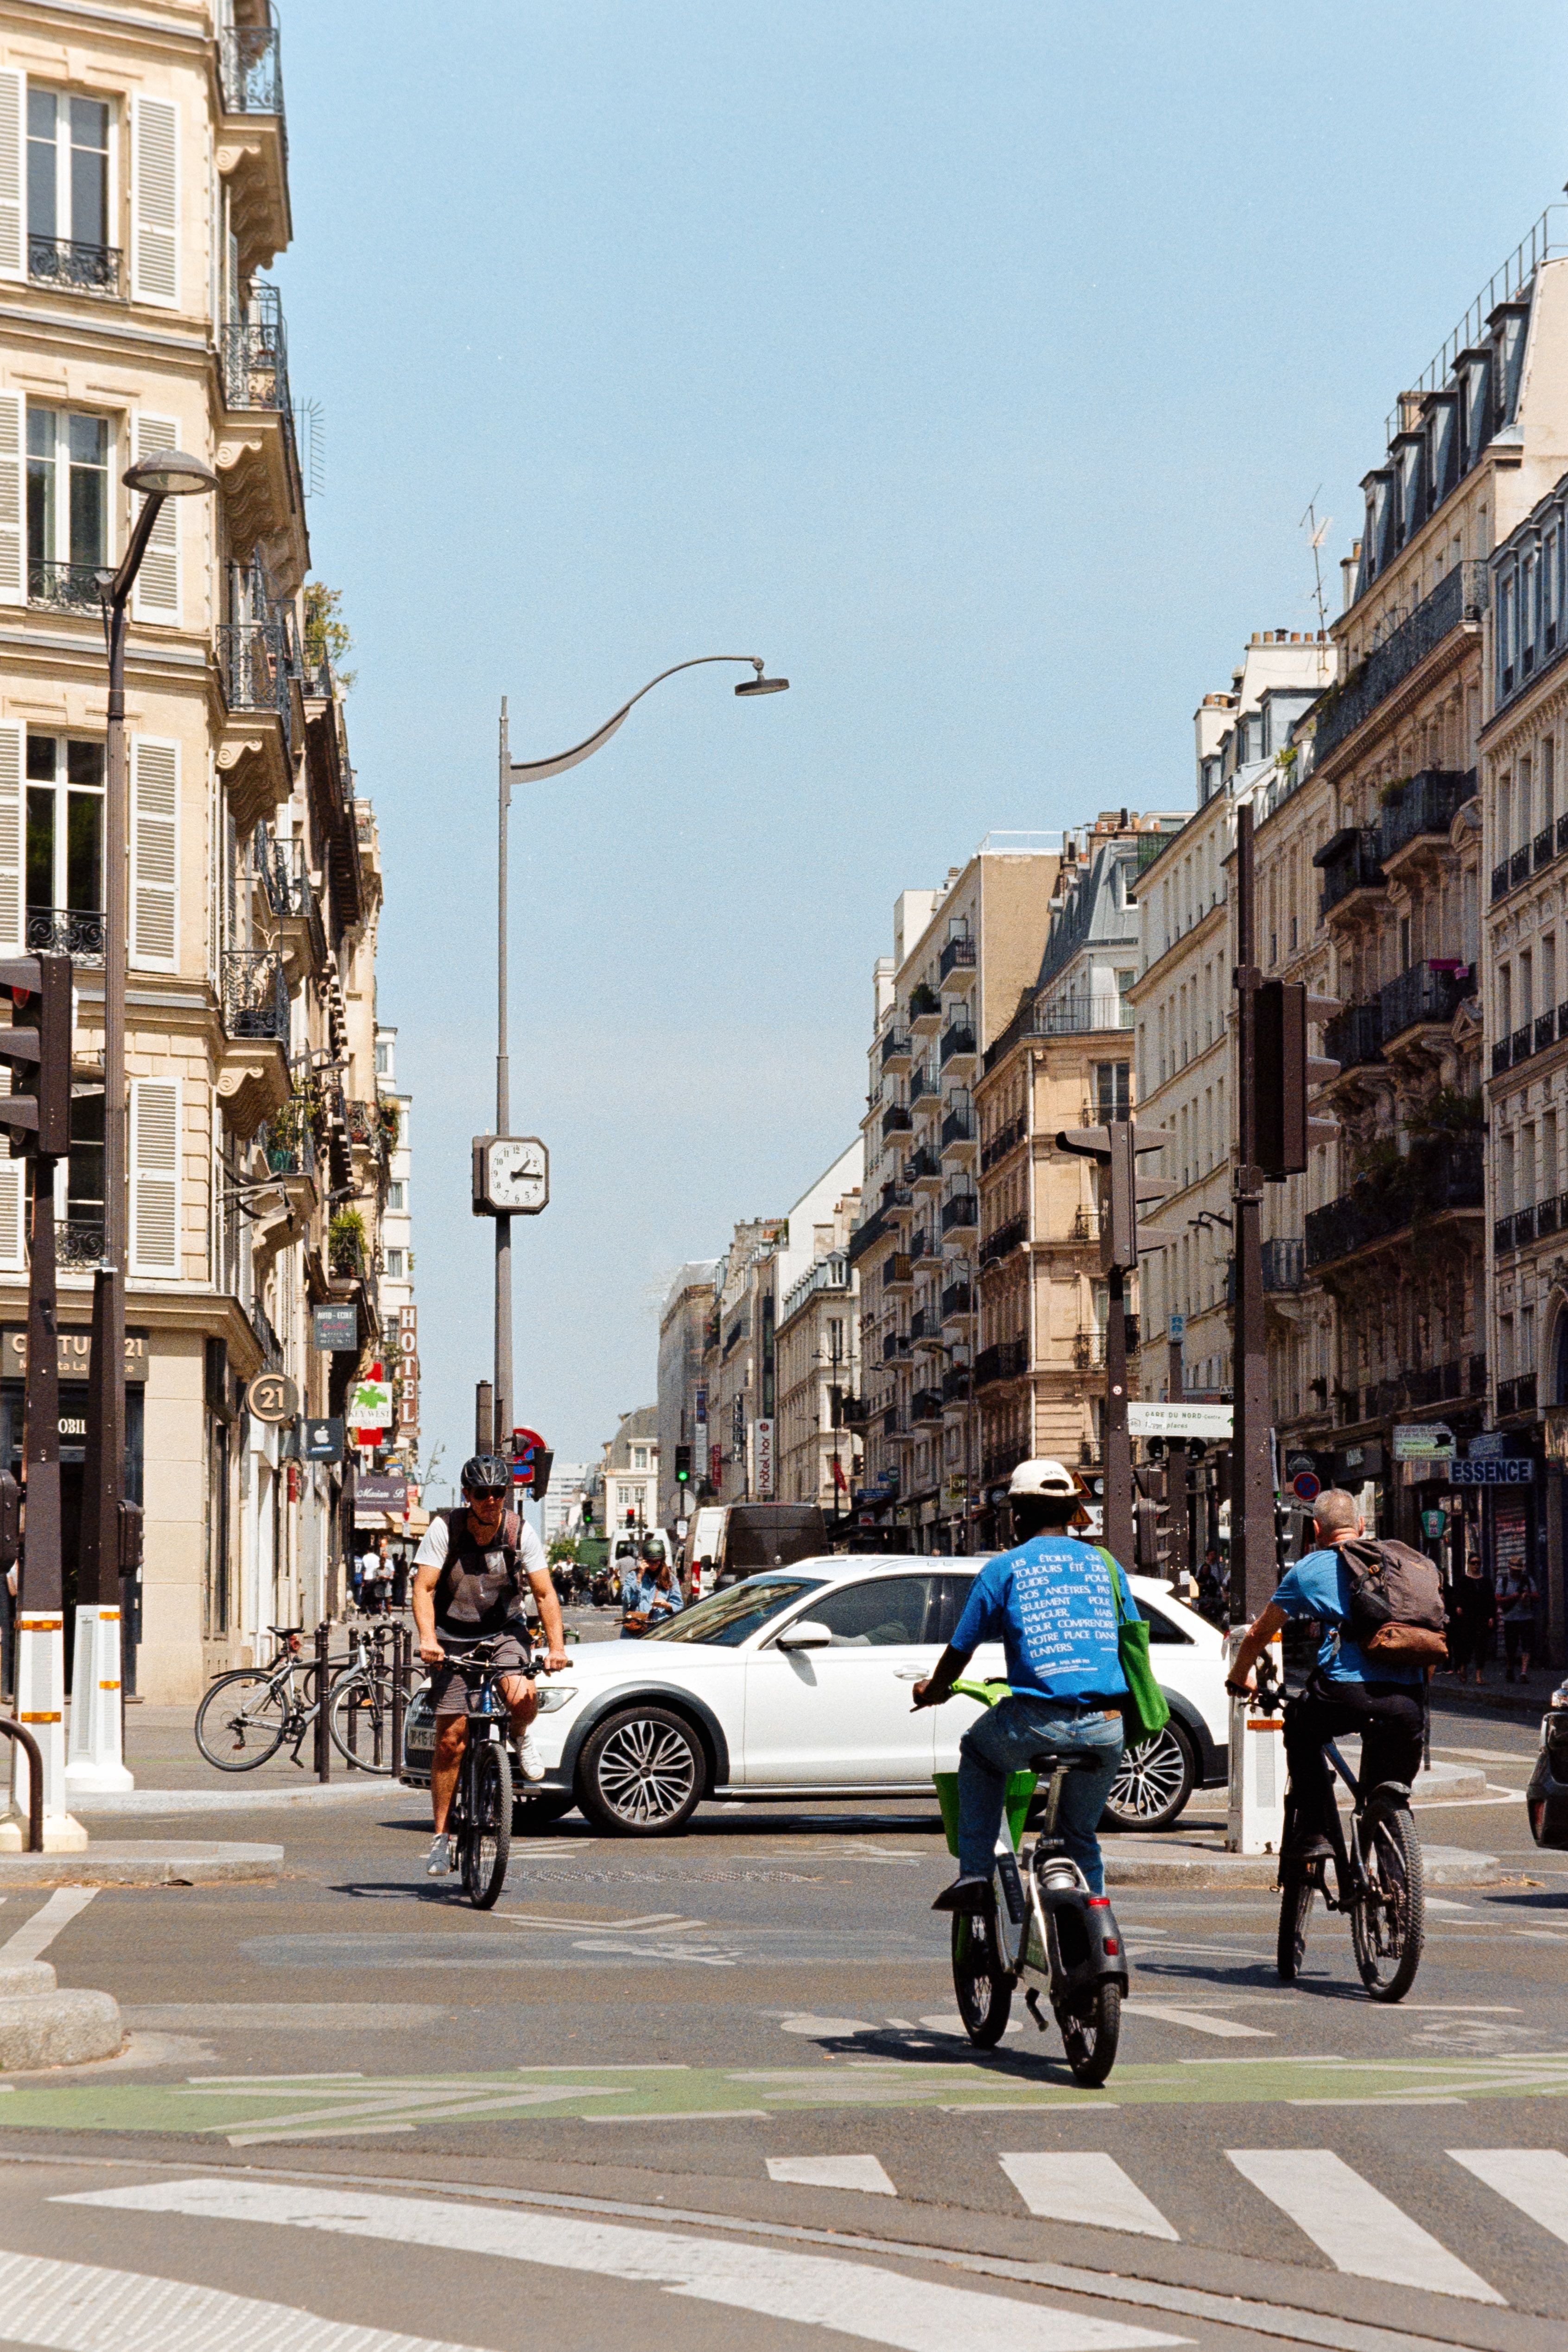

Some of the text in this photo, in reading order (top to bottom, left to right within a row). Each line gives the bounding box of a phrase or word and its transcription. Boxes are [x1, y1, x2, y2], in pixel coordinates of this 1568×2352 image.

[124, 1338, 143, 1357] 21
[73, 1361, 87, 1371] La
[401, 1309, 415, 1423] HOTEL
[260, 1387, 284, 1408] 21
[758, 1457, 770, 1488] hôtel
[1451, 1460, 1529, 1482] ESSENCE
[393, 1488, 405, 1498] B
[1011, 1558, 1027, 1569] LES
[1039, 1554, 1073, 1563] ÉTOILES
[1014, 1564, 1063, 1579] TOUJOURS
[1069, 1562, 1085, 1572] ÉTÉ
[1016, 1574, 1110, 1591] GUIDES POUR
[1019, 1589, 1039, 1602] NOS
[1097, 1585, 1110, 1595] PAS
[1020, 1596, 1111, 1613] SEULEMENT POUR
[1022, 1608, 1113, 1623] NAVIGUER, MAIS
[1024, 1618, 1116, 1636] POUR COMPRENDRE
[1027, 1630, 1117, 1647] NOTRE PLACE DANS
